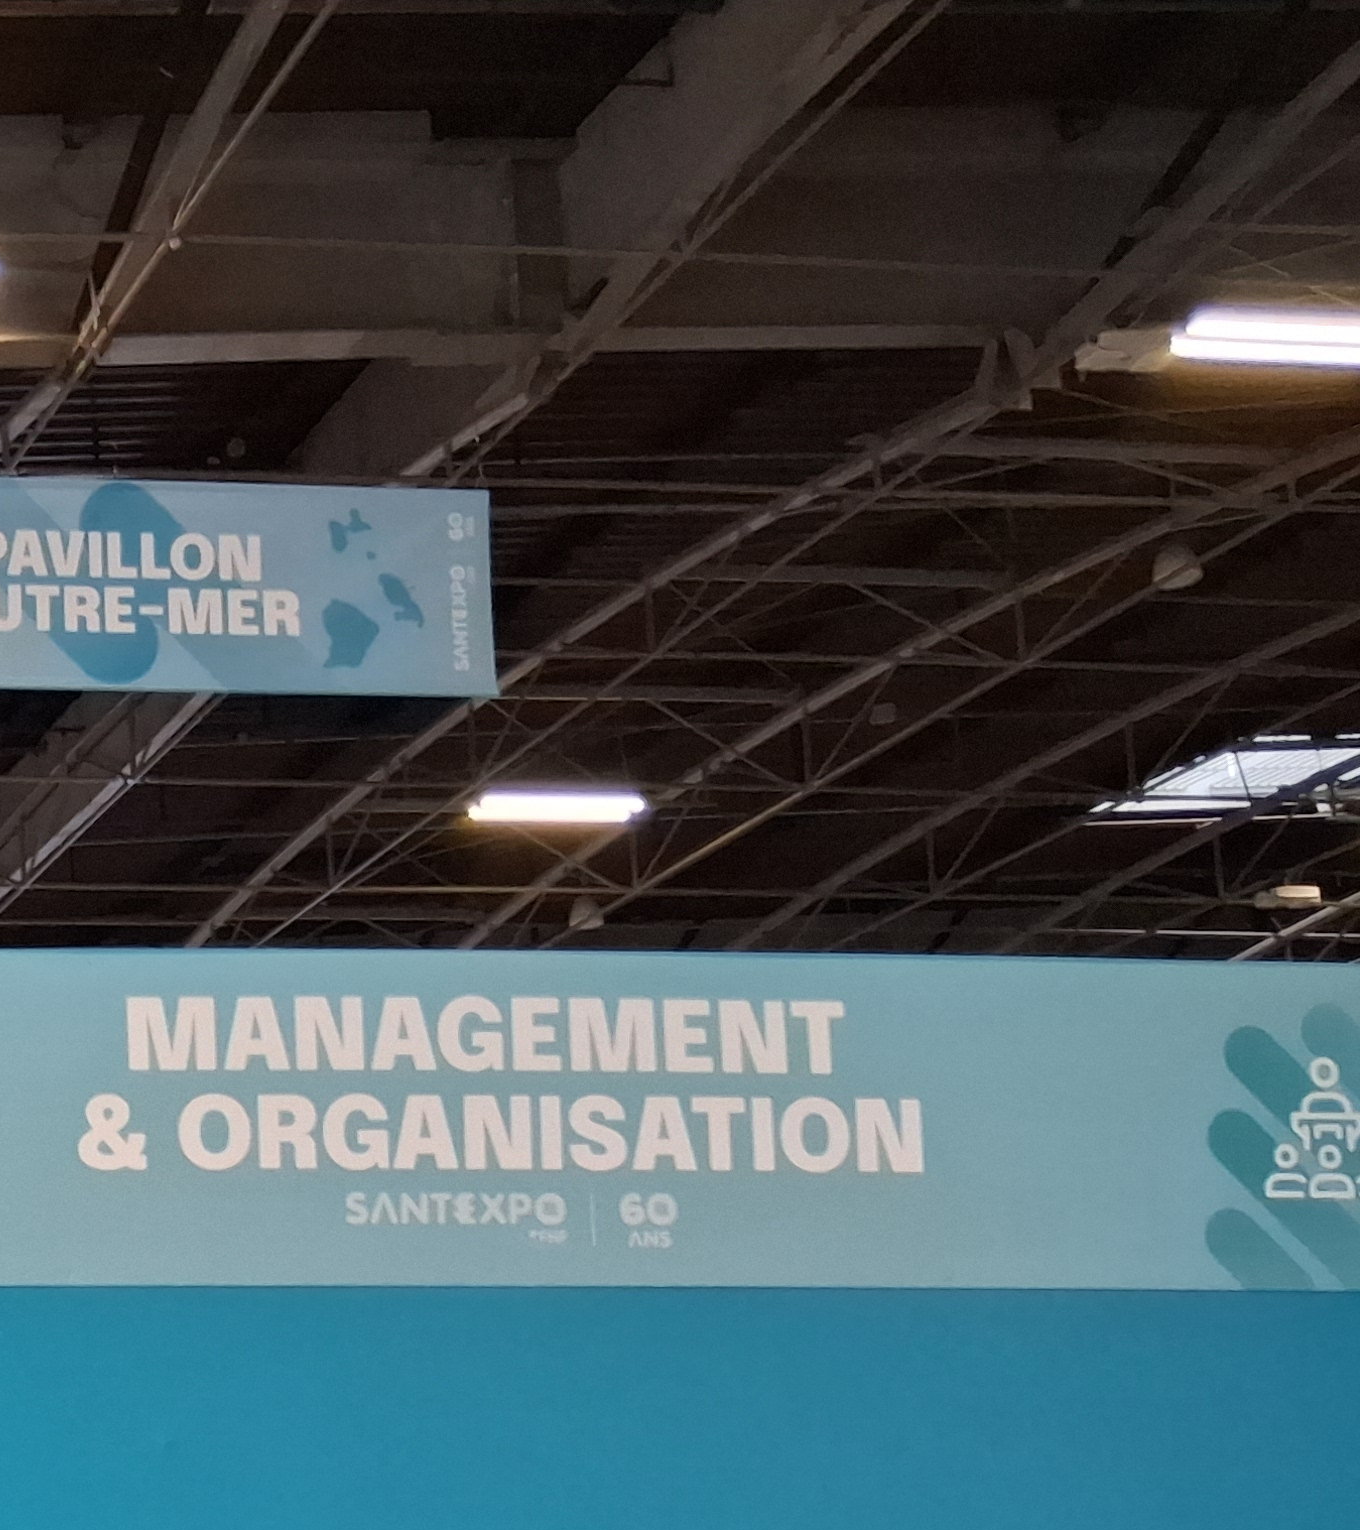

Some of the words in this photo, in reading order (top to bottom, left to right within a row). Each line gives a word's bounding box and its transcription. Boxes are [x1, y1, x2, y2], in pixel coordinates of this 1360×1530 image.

[126, 996, 845, 1075] MANAGEMENT
[78, 1093, 147, 1171] &
[178, 1093, 925, 1173] ORGANISATION
[619, 1191, 678, 1226] 60
[629, 1230, 673, 1249] ANS
